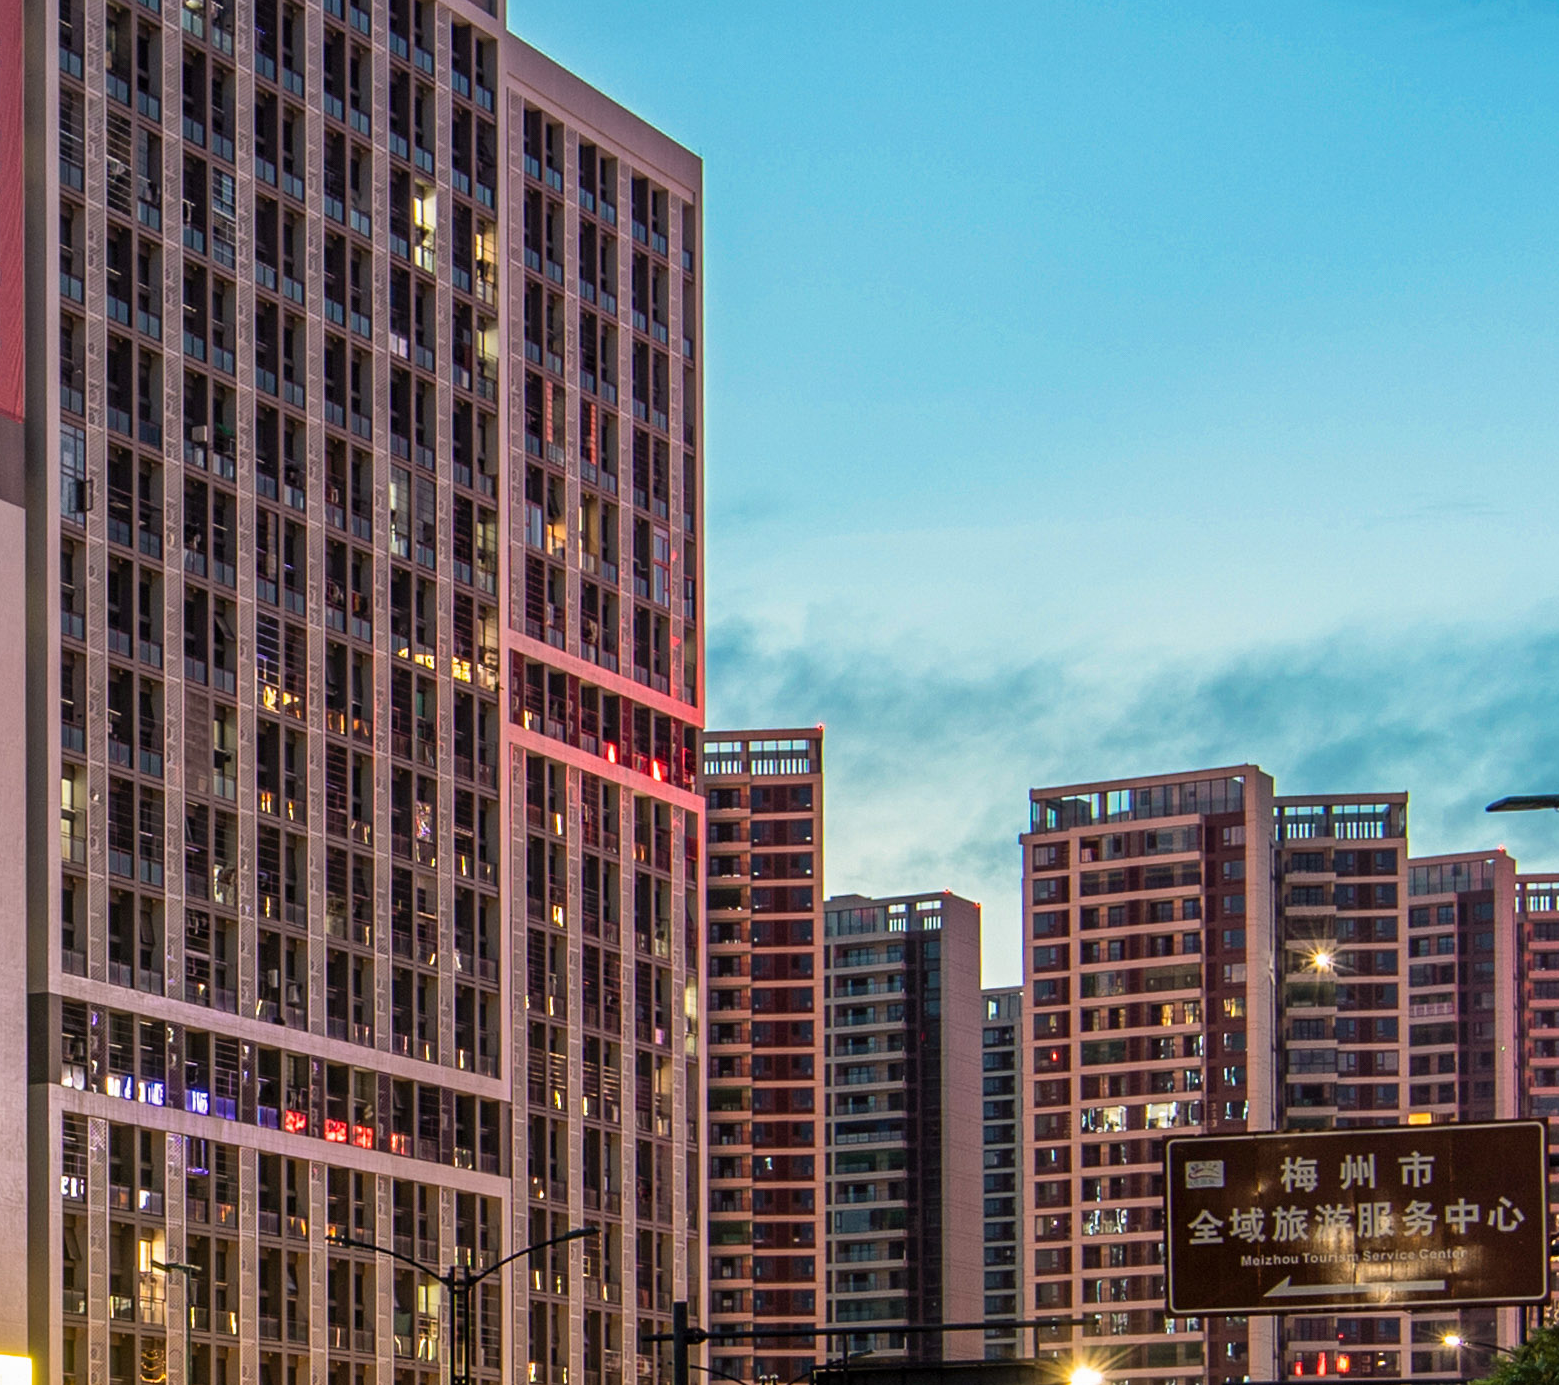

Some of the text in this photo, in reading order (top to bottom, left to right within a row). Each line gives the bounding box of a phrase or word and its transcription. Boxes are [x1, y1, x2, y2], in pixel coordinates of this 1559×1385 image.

[1280, 1151, 1435, 1193] 梅州市
[1187, 1196, 1525, 1245] 全域旅游服务中心
[1241, 1247, 1467, 1267] Meizhou Tourism Service Center
